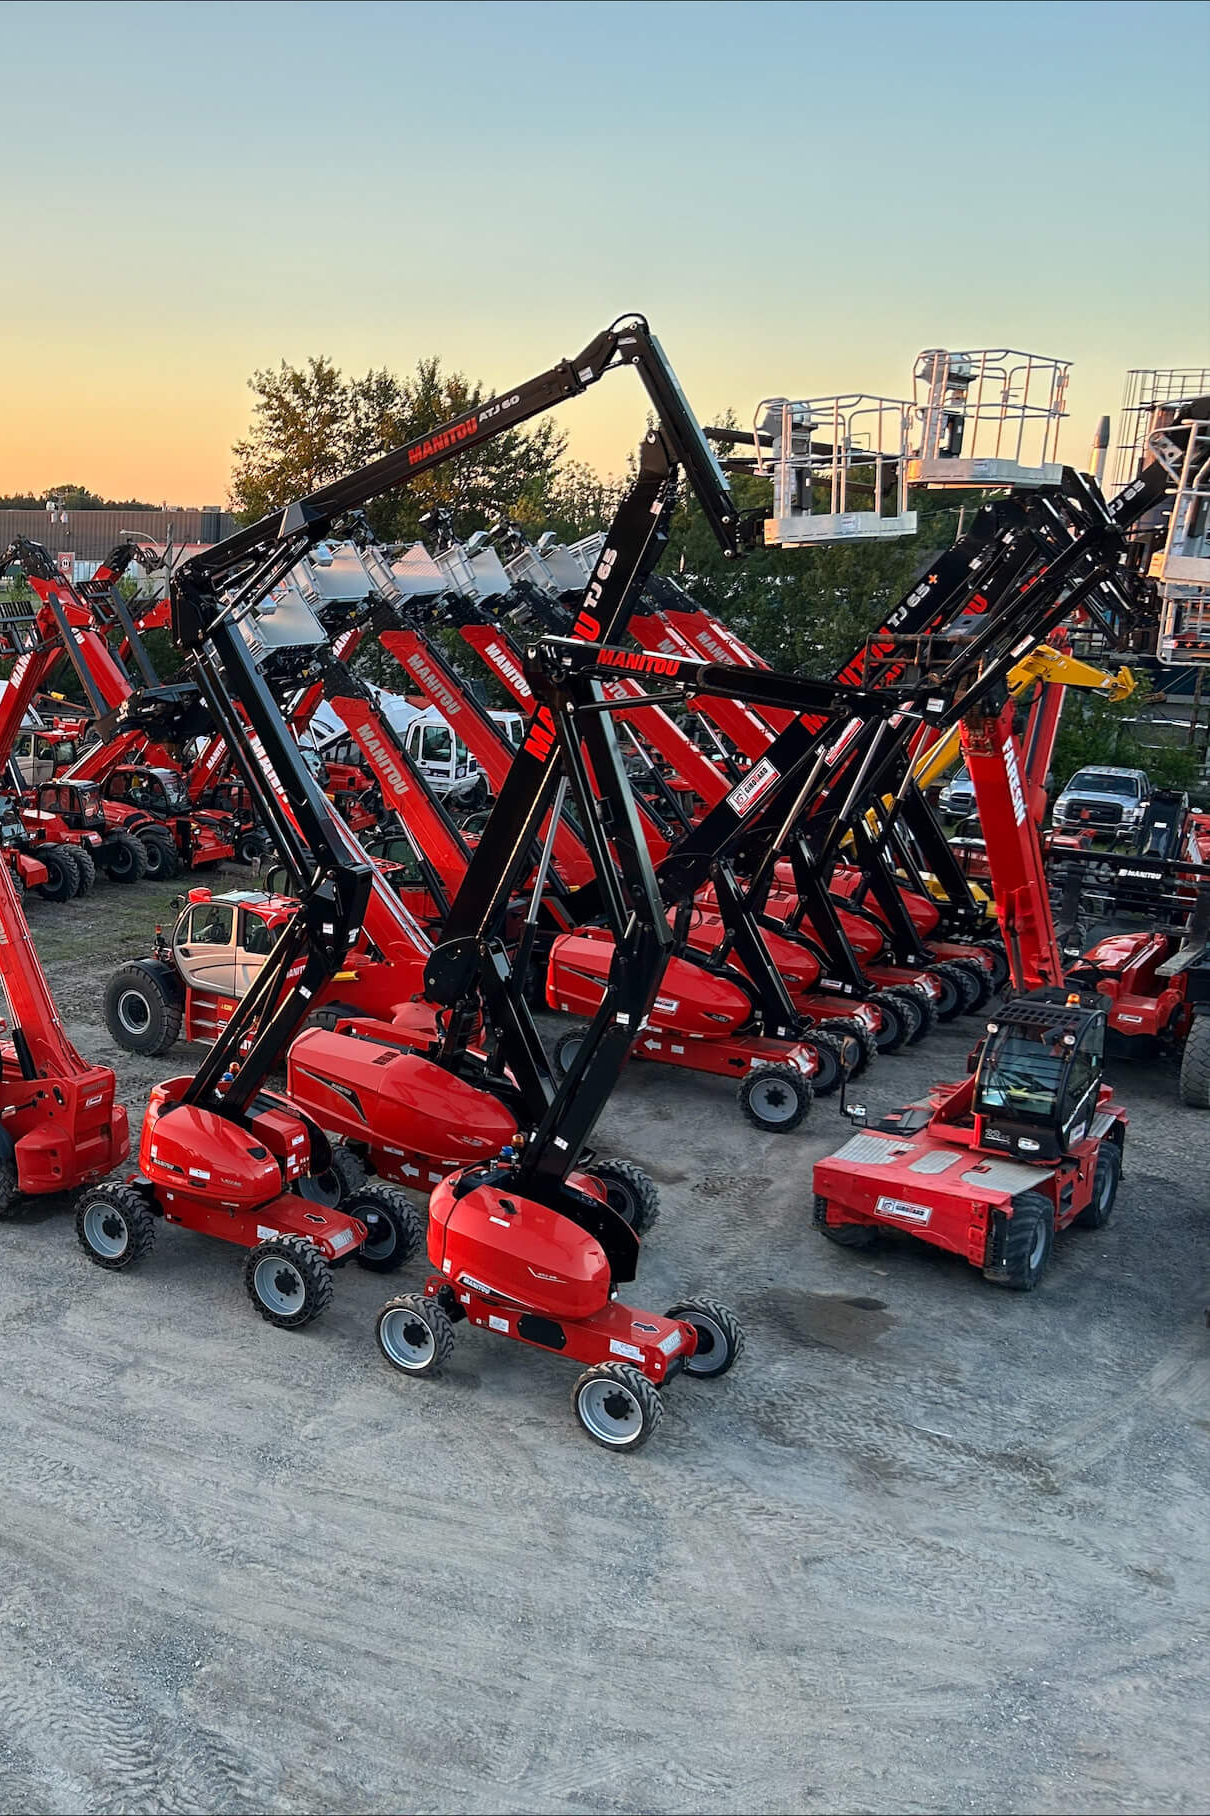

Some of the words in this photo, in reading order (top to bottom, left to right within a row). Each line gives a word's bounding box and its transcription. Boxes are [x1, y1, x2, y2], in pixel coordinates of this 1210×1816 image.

[408, 416, 478, 465] MANITOU
[479, 404, 501, 422] ATJ
[501, 394, 520, 410] 60
[583, 582, 603, 608] TJ
[596, 548, 618, 580] 65
[331, 627, 361, 657] MANI
[887, 607, 908, 627] TJ
[406, 653, 462, 716] MANITOU
[484, 642, 533, 698] MANITOU
[597, 648, 681, 676] MANITOU
[356, 723, 409, 795] MANITOU
[1127, 870, 1162, 880] MANITOU
